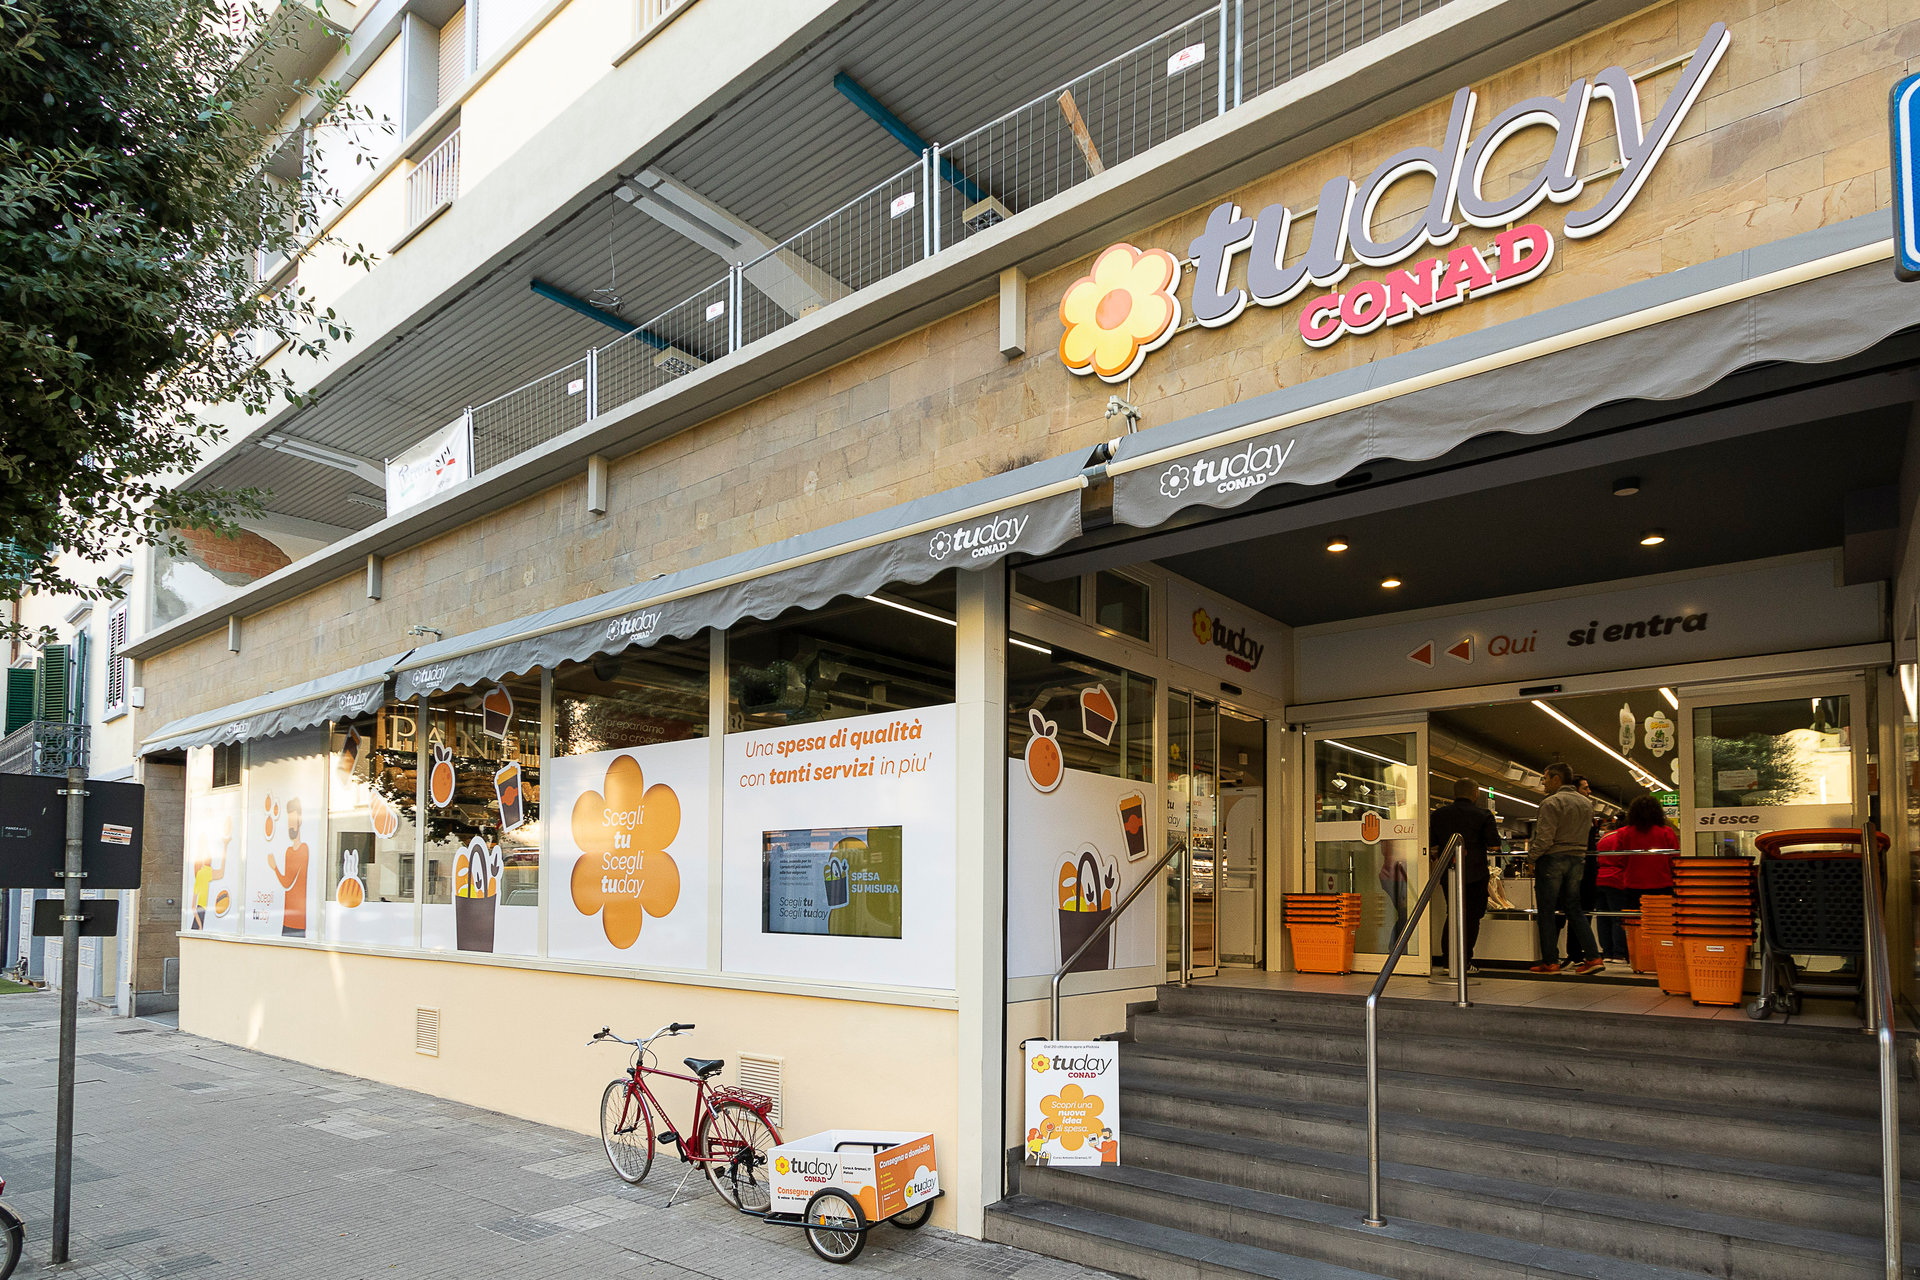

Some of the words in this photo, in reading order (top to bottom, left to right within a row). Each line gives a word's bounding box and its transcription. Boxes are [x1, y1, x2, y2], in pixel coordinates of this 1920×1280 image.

[1189, 21, 1731, 328] tuday
[1300, 224, 1554, 348] CONAD
[1192, 438, 1296, 488] tuday
[1217, 473, 1267, 494] CONAD
[953, 514, 1030, 550] tuday
[971, 542, 1008, 559] CONAD
[620, 610, 662, 636] tuday
[1211, 617, 1265, 670] tuday
[1487, 629, 1538, 657] Qui
[1567, 620, 1599, 647] si
[1602, 612, 1708, 643] entra
[420, 664, 449, 683] tuday
[745, 740, 774, 758] Una
[776, 734, 827, 759] spesa
[829, 726, 849, 748] di
[850, 718, 923, 751] qualità
[739, 772, 766, 788] con
[769, 762, 813, 785] tanti
[813, 756, 876, 781] servizi
[880, 756, 895, 776] in
[898, 751, 933, 778] piu'
[601, 805, 645, 831] Scegli
[1393, 823, 1415, 834] Qui
[1699, 813, 1717, 825] si
[1718, 813, 1760, 825] esce
[614, 831, 632, 850] tu
[601, 850, 645, 875] Scegli
[600, 874, 645, 899] tuday
[851, 872, 880, 881] SPESA
[851, 884, 863, 893] SU
[864, 884, 900, 893] MISURA
[779, 897, 802, 909] Scegli
[803, 897, 813, 907] tu
[779, 907, 802, 919] Scegli
[803, 908, 828, 920] tuday
[1052, 1054, 1113, 1076] tuday
[1051, 1101, 1077, 1110] Scopri
[1055, 1124, 1063, 1132] di
[1063, 1126, 1089, 1134] spesa.
[1062, 1116, 1082, 1124] idea
[879, 1154, 905, 1169] Consegna
[908, 1143, 931, 1158] domicilio
[791, 1157, 838, 1180] tuday
[803, 1175, 827, 1183] CONAD
[777, 1186, 809, 1197] Consegna
[914, 1177, 937, 1194] tuday
